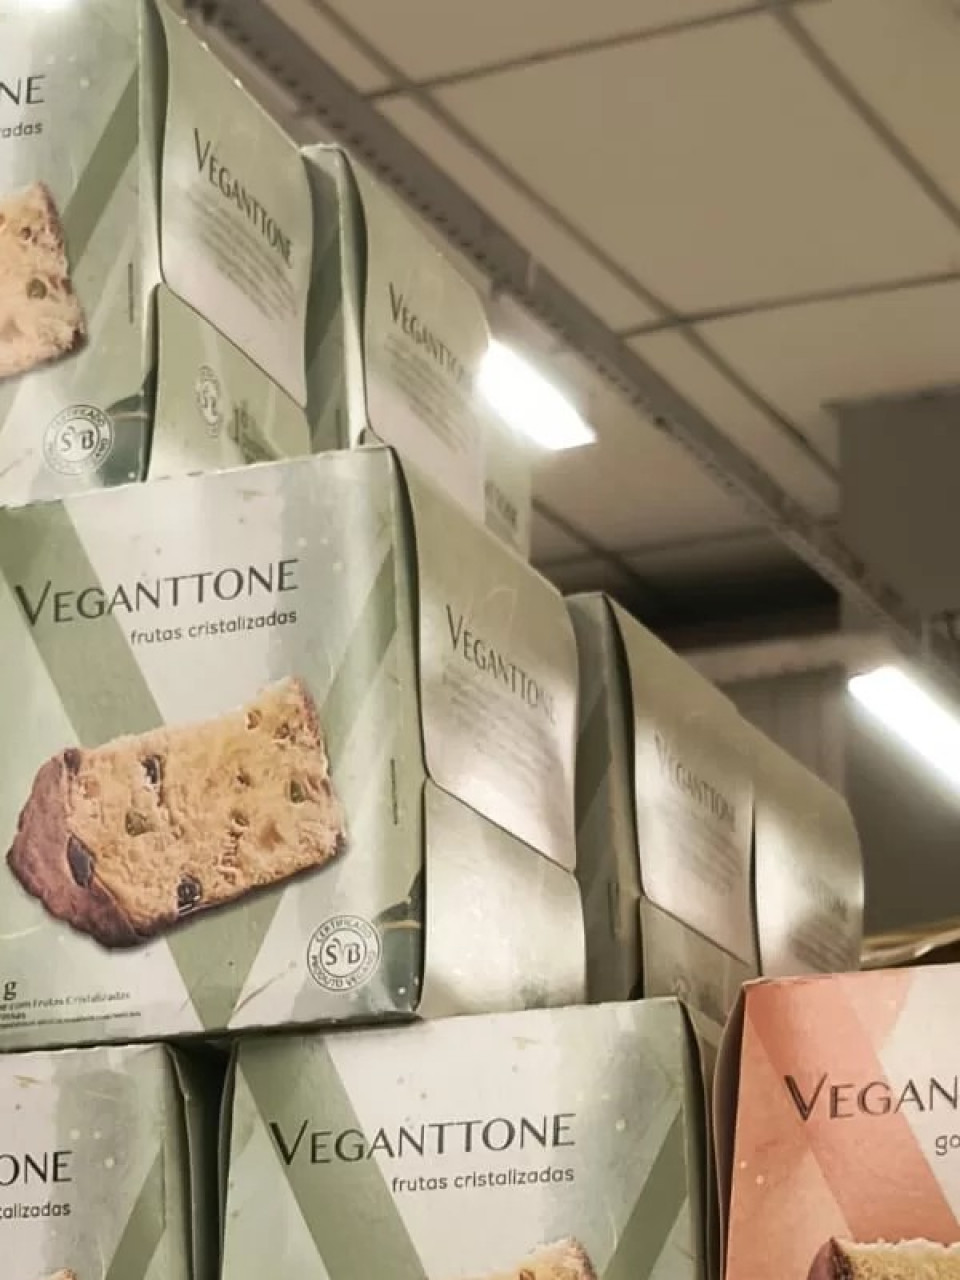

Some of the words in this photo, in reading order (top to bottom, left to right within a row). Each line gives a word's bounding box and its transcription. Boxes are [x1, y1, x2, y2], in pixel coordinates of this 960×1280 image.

[194, 128, 293, 268] VEGANTTONE
[14, 559, 299, 626] VEGANTTONE
[130, 627, 183, 646] frutas
[188, 608, 297, 640] cristalizadas
[5, 981, 17, 1000] g
[270, 1112, 576, 1167] VEGANTTONE
[391, 1175, 448, 1193] frutas
[453, 1166, 574, 1190] cristalizadas
